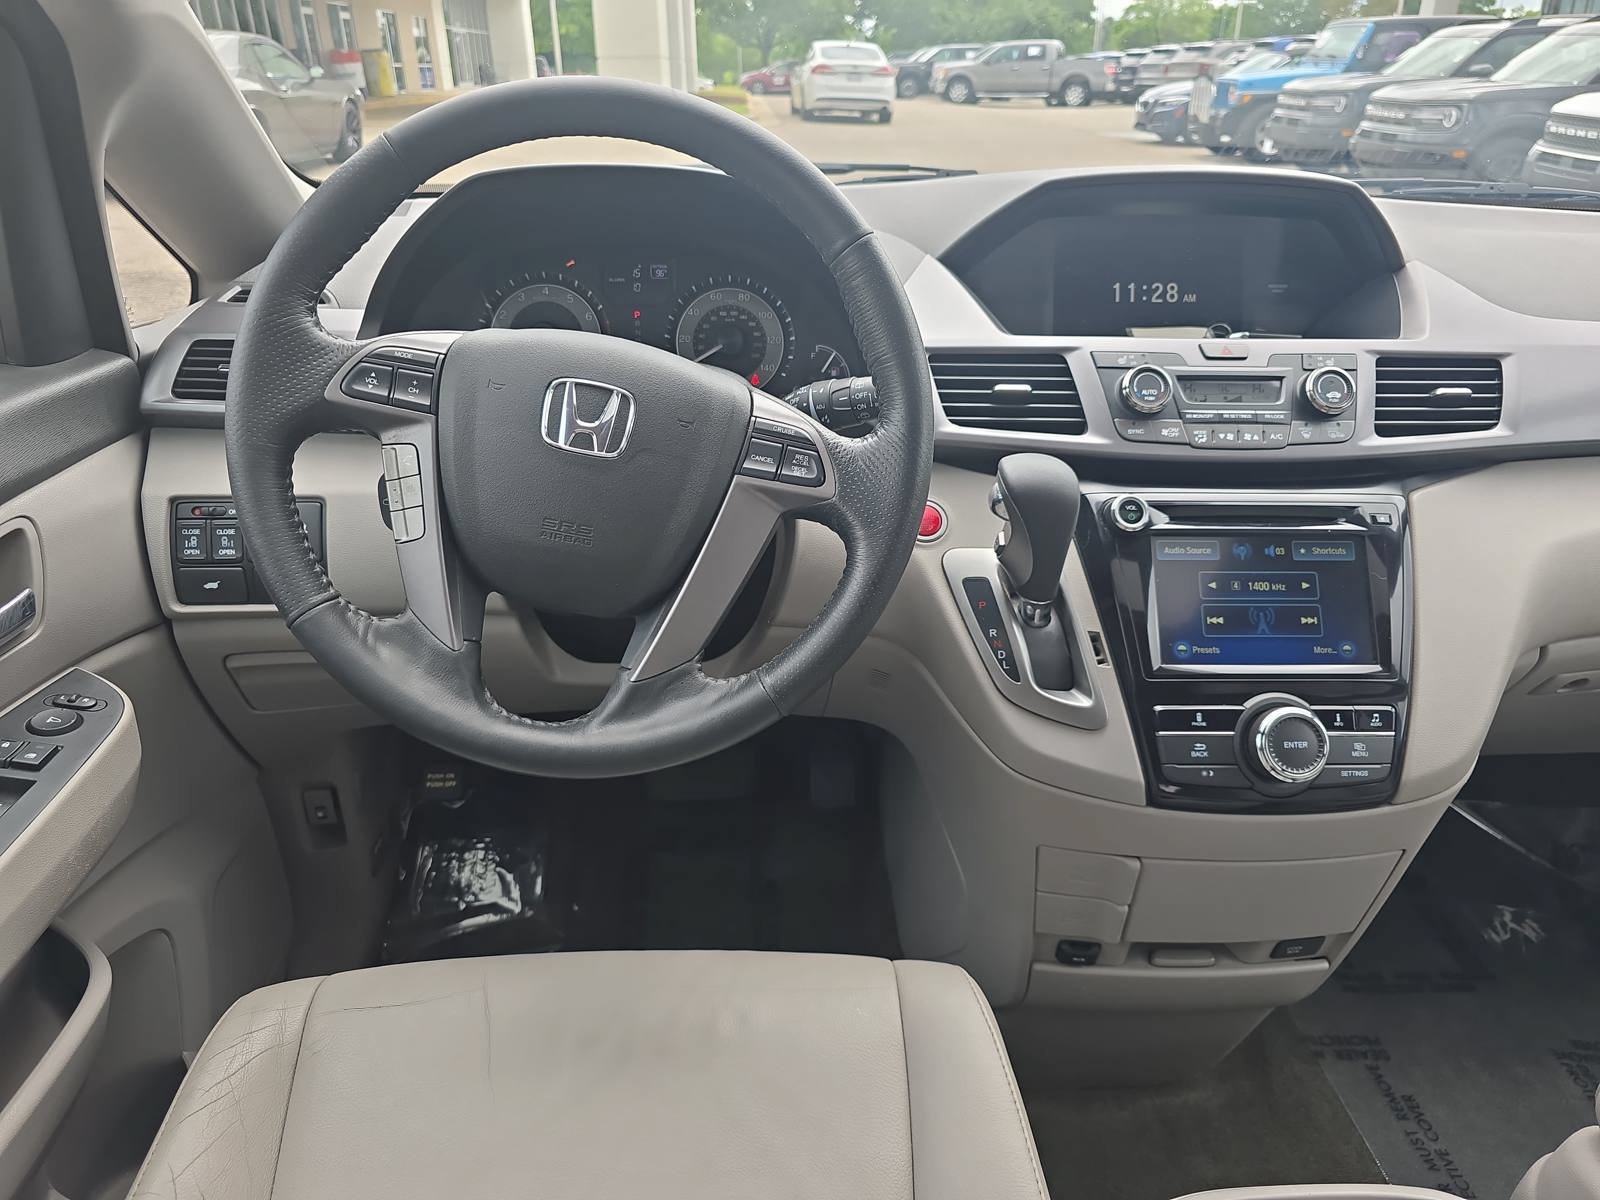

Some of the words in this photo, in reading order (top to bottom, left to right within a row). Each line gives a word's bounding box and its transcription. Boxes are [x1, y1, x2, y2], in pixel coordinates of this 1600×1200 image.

[1550, 126, 1600, 139] BRONC
[541, 287, 549, 295] 4
[1112, 282, 1179, 303] 11:28
[1183, 295, 1196, 303] AM
[567, 294, 574, 303] 5
[738, 293, 750, 301] 80
[585, 312, 593, 320] 6
[633, 310, 641, 319] P
[687, 308, 700, 316] 40
[758, 311, 773, 319] 100
[679, 335, 691, 343] 20
[767, 336, 782, 344] 120
[394, 351, 414, 359] MODE
[760, 364, 775, 372] 140
[365, 377, 379, 385] VOL
[407, 386, 419, 394] CH
[855, 391, 868, 400] OFF
[773, 426, 796, 435] CRUISE
[750, 454, 775, 464] CANCEL
[794, 453, 809, 461] RES
[541, 518, 594, 537] SRS
[540, 531, 593, 548] AIRBAG
[1163, 546, 1184, 555] Audio
[1185, 546, 1211, 555] Source
[1275, 547, 1285, 555] 03
[1311, 546, 1347, 555] Shortcuts
[1248, 581, 1269, 591] 1400
[1271, 582, 1287, 591] kHz
[978, 601, 986, 609] P
[989, 628, 997, 637] R
[998, 650, 1006, 659] D
[1192, 646, 1220, 655] Presets
[1002, 661, 1010, 669] L
[1283, 741, 1308, 749] ENTER
[1190, 750, 1209, 758] BACK
[1366, 1063, 1410, 1121] REMOVE
[1402, 1093, 1439, 1143] COVER
[1404, 1128, 1440, 1172] MUST
